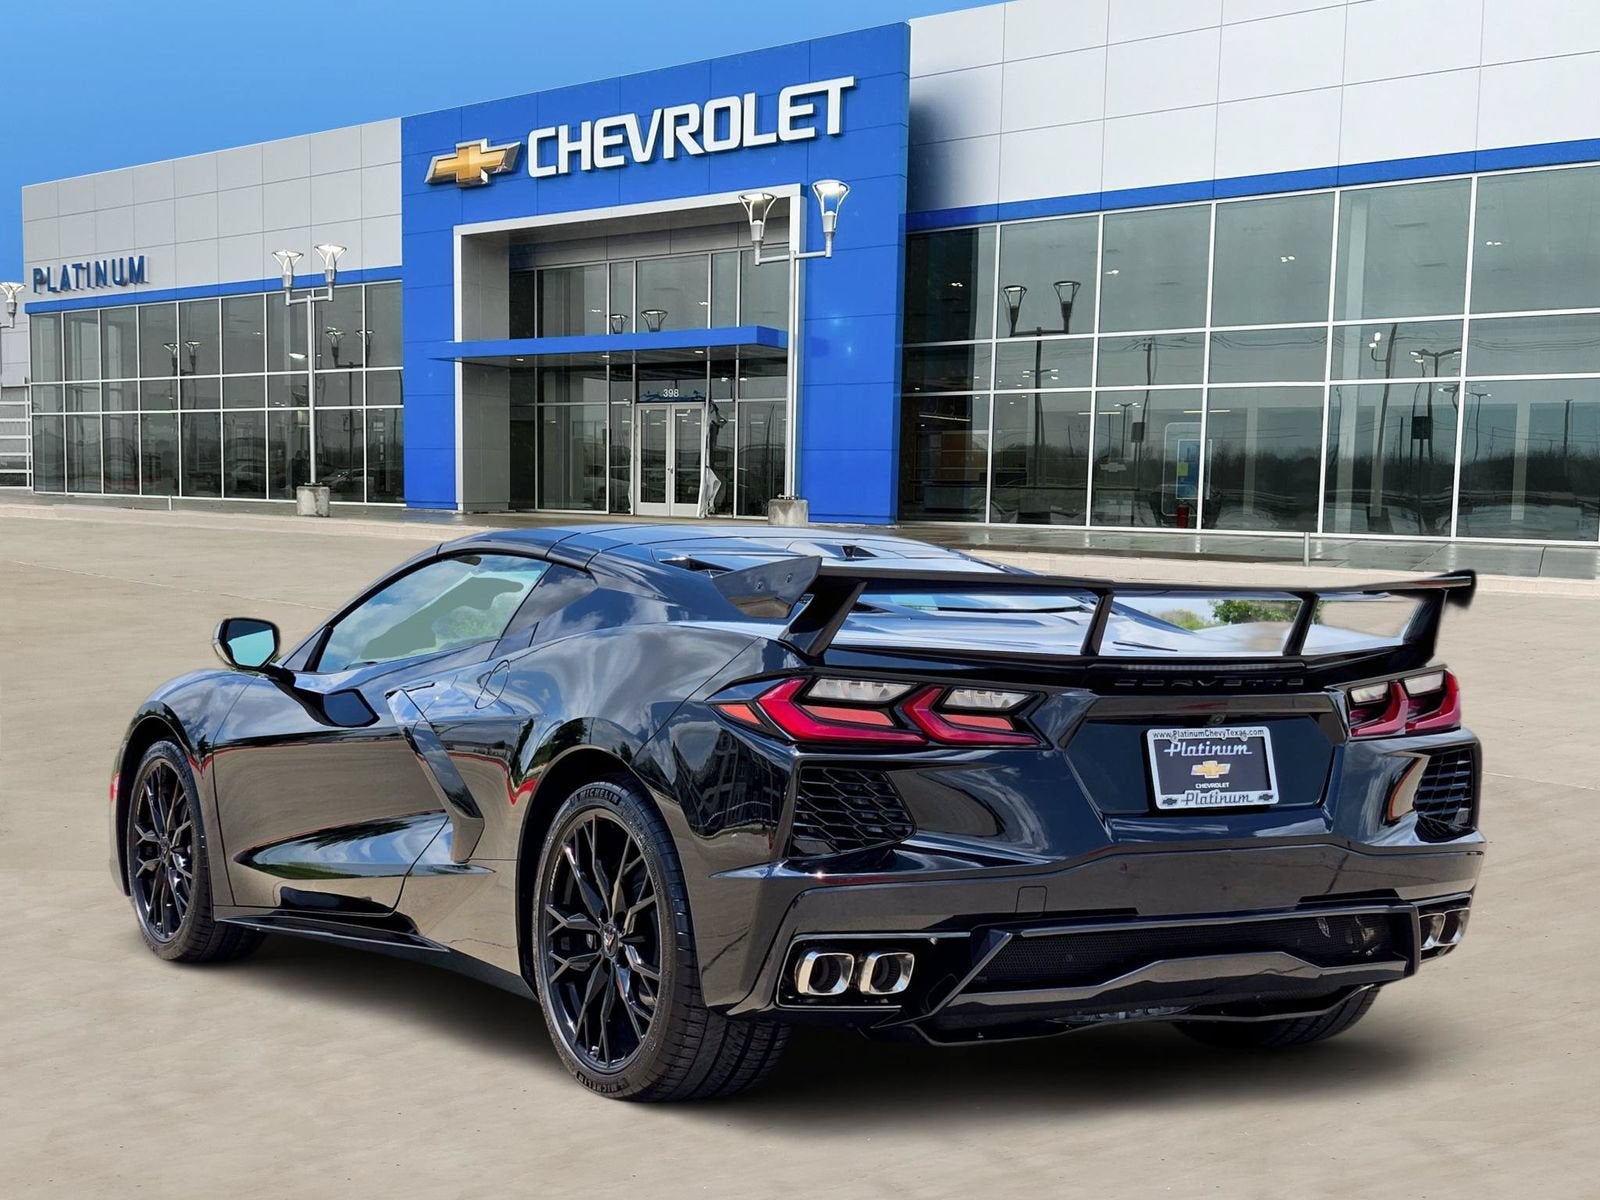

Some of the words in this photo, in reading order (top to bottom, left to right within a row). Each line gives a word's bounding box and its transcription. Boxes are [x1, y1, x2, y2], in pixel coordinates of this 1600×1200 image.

[528, 75, 855, 178] CHEVROLET
[33, 255, 146, 294] PLATINUM
[663, 388, 679, 397] 398
[1164, 741, 1253, 757] Platinum
[579, 788, 620, 804] MICHELIN
[1182, 791, 1254, 806] Platinum
